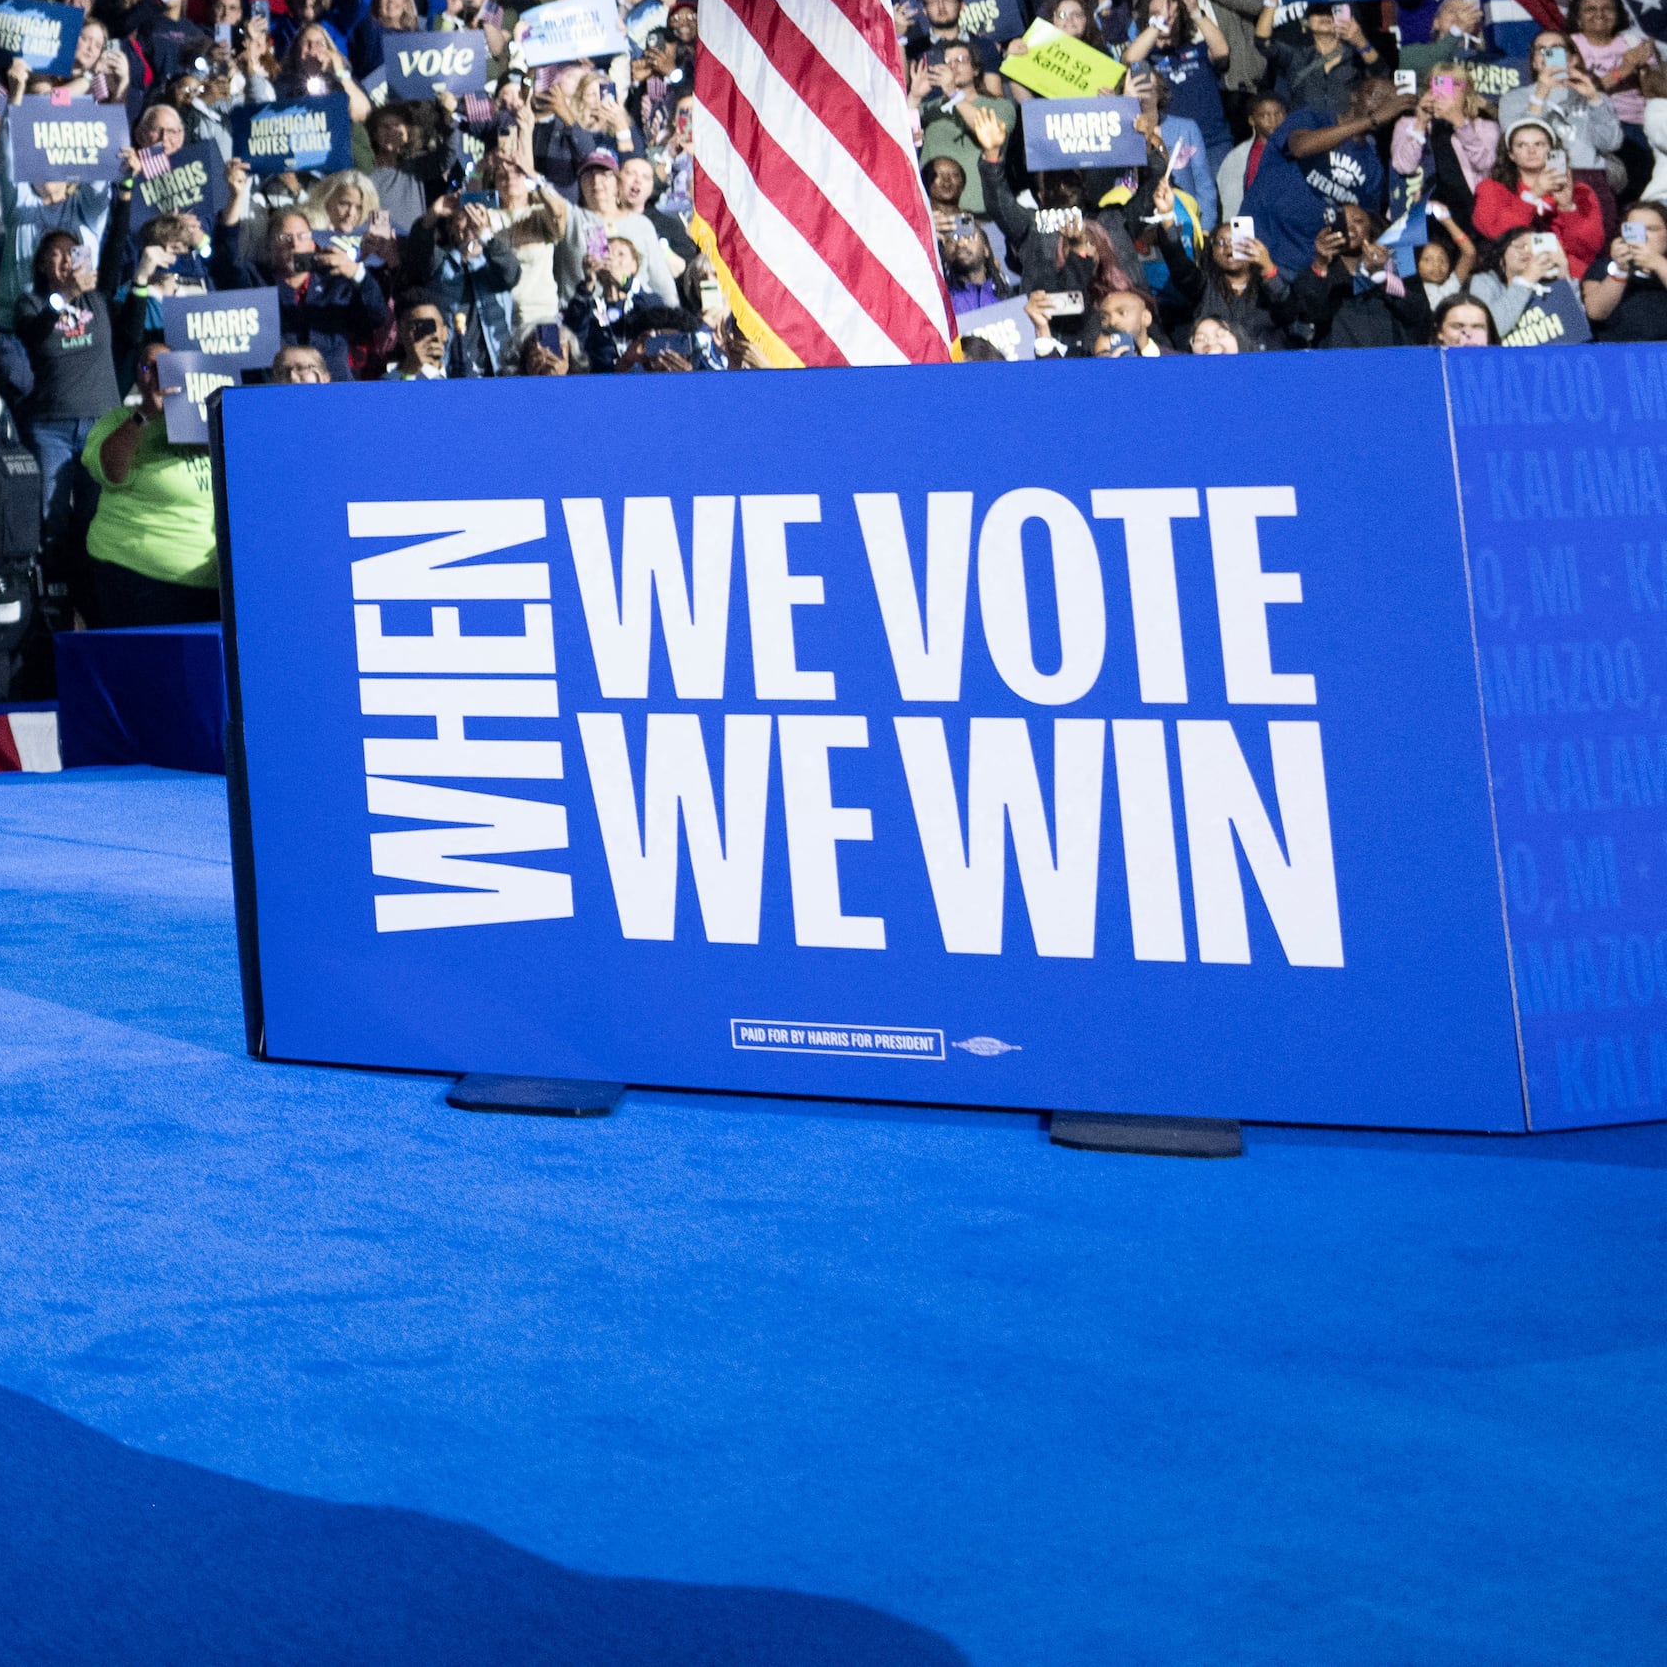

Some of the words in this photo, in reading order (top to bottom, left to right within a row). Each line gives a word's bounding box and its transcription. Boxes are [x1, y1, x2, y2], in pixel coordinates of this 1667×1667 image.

[21, 33, 62, 58] EARLY
[397, 41, 475, 78] vote
[1047, 42, 1069, 63] i'm
[1070, 59, 1092, 76] so
[1032, 54, 1090, 92] kamala
[33, 120, 109, 150] HARRIS
[250, 110, 327, 136] MICHIGAN
[1045, 110, 1122, 140] HARRIS
[46, 146, 98, 166] WALZ
[247, 133, 290, 155] VOTES
[290, 130, 331, 155] EARLY
[1058, 135, 1112, 154] WALZ
[139, 159, 208, 208] HARRIS
[156, 184, 205, 214] WALZ
[186, 307, 260, 336] HARRIS
[61, 332, 93, 349] LADY
[199, 336, 250, 355] WALZ
[562, 494, 835, 700] WE
[854, 486, 1316, 705] VOTE
[347, 499, 573, 932] WHEN
[577, 713, 886, 949] WE
[893, 717, 1344, 967] WIN
[740, 1027, 765, 1042] PAID
[768, 1029, 789, 1042] FOR
[791, 1030, 806, 1044] BY
[808, 1031, 849, 1046] HARRIS
[851, 1033, 873, 1048] FOR
[875, 1034, 934, 1051] PRESIDENT
